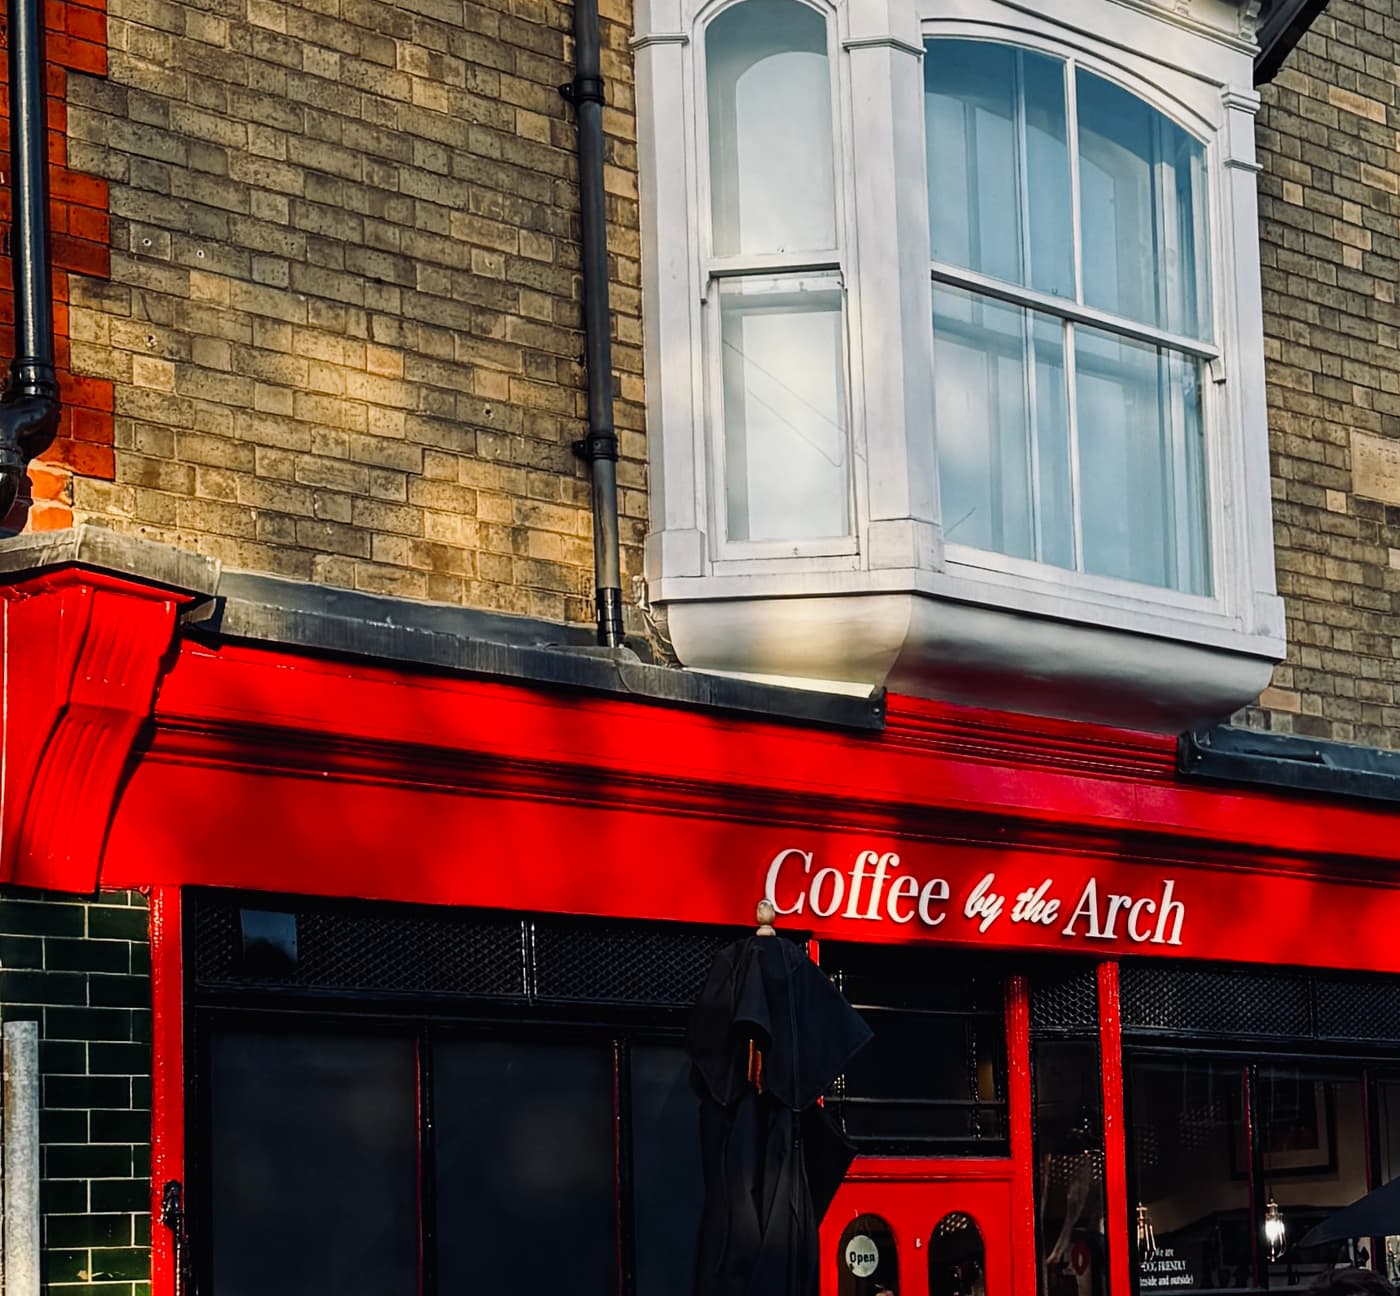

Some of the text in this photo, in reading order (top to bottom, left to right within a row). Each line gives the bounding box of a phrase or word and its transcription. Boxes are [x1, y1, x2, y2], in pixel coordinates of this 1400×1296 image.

[765, 848, 1186, 946] Coffee by the Arch
[850, 1251, 876, 1264] Open
